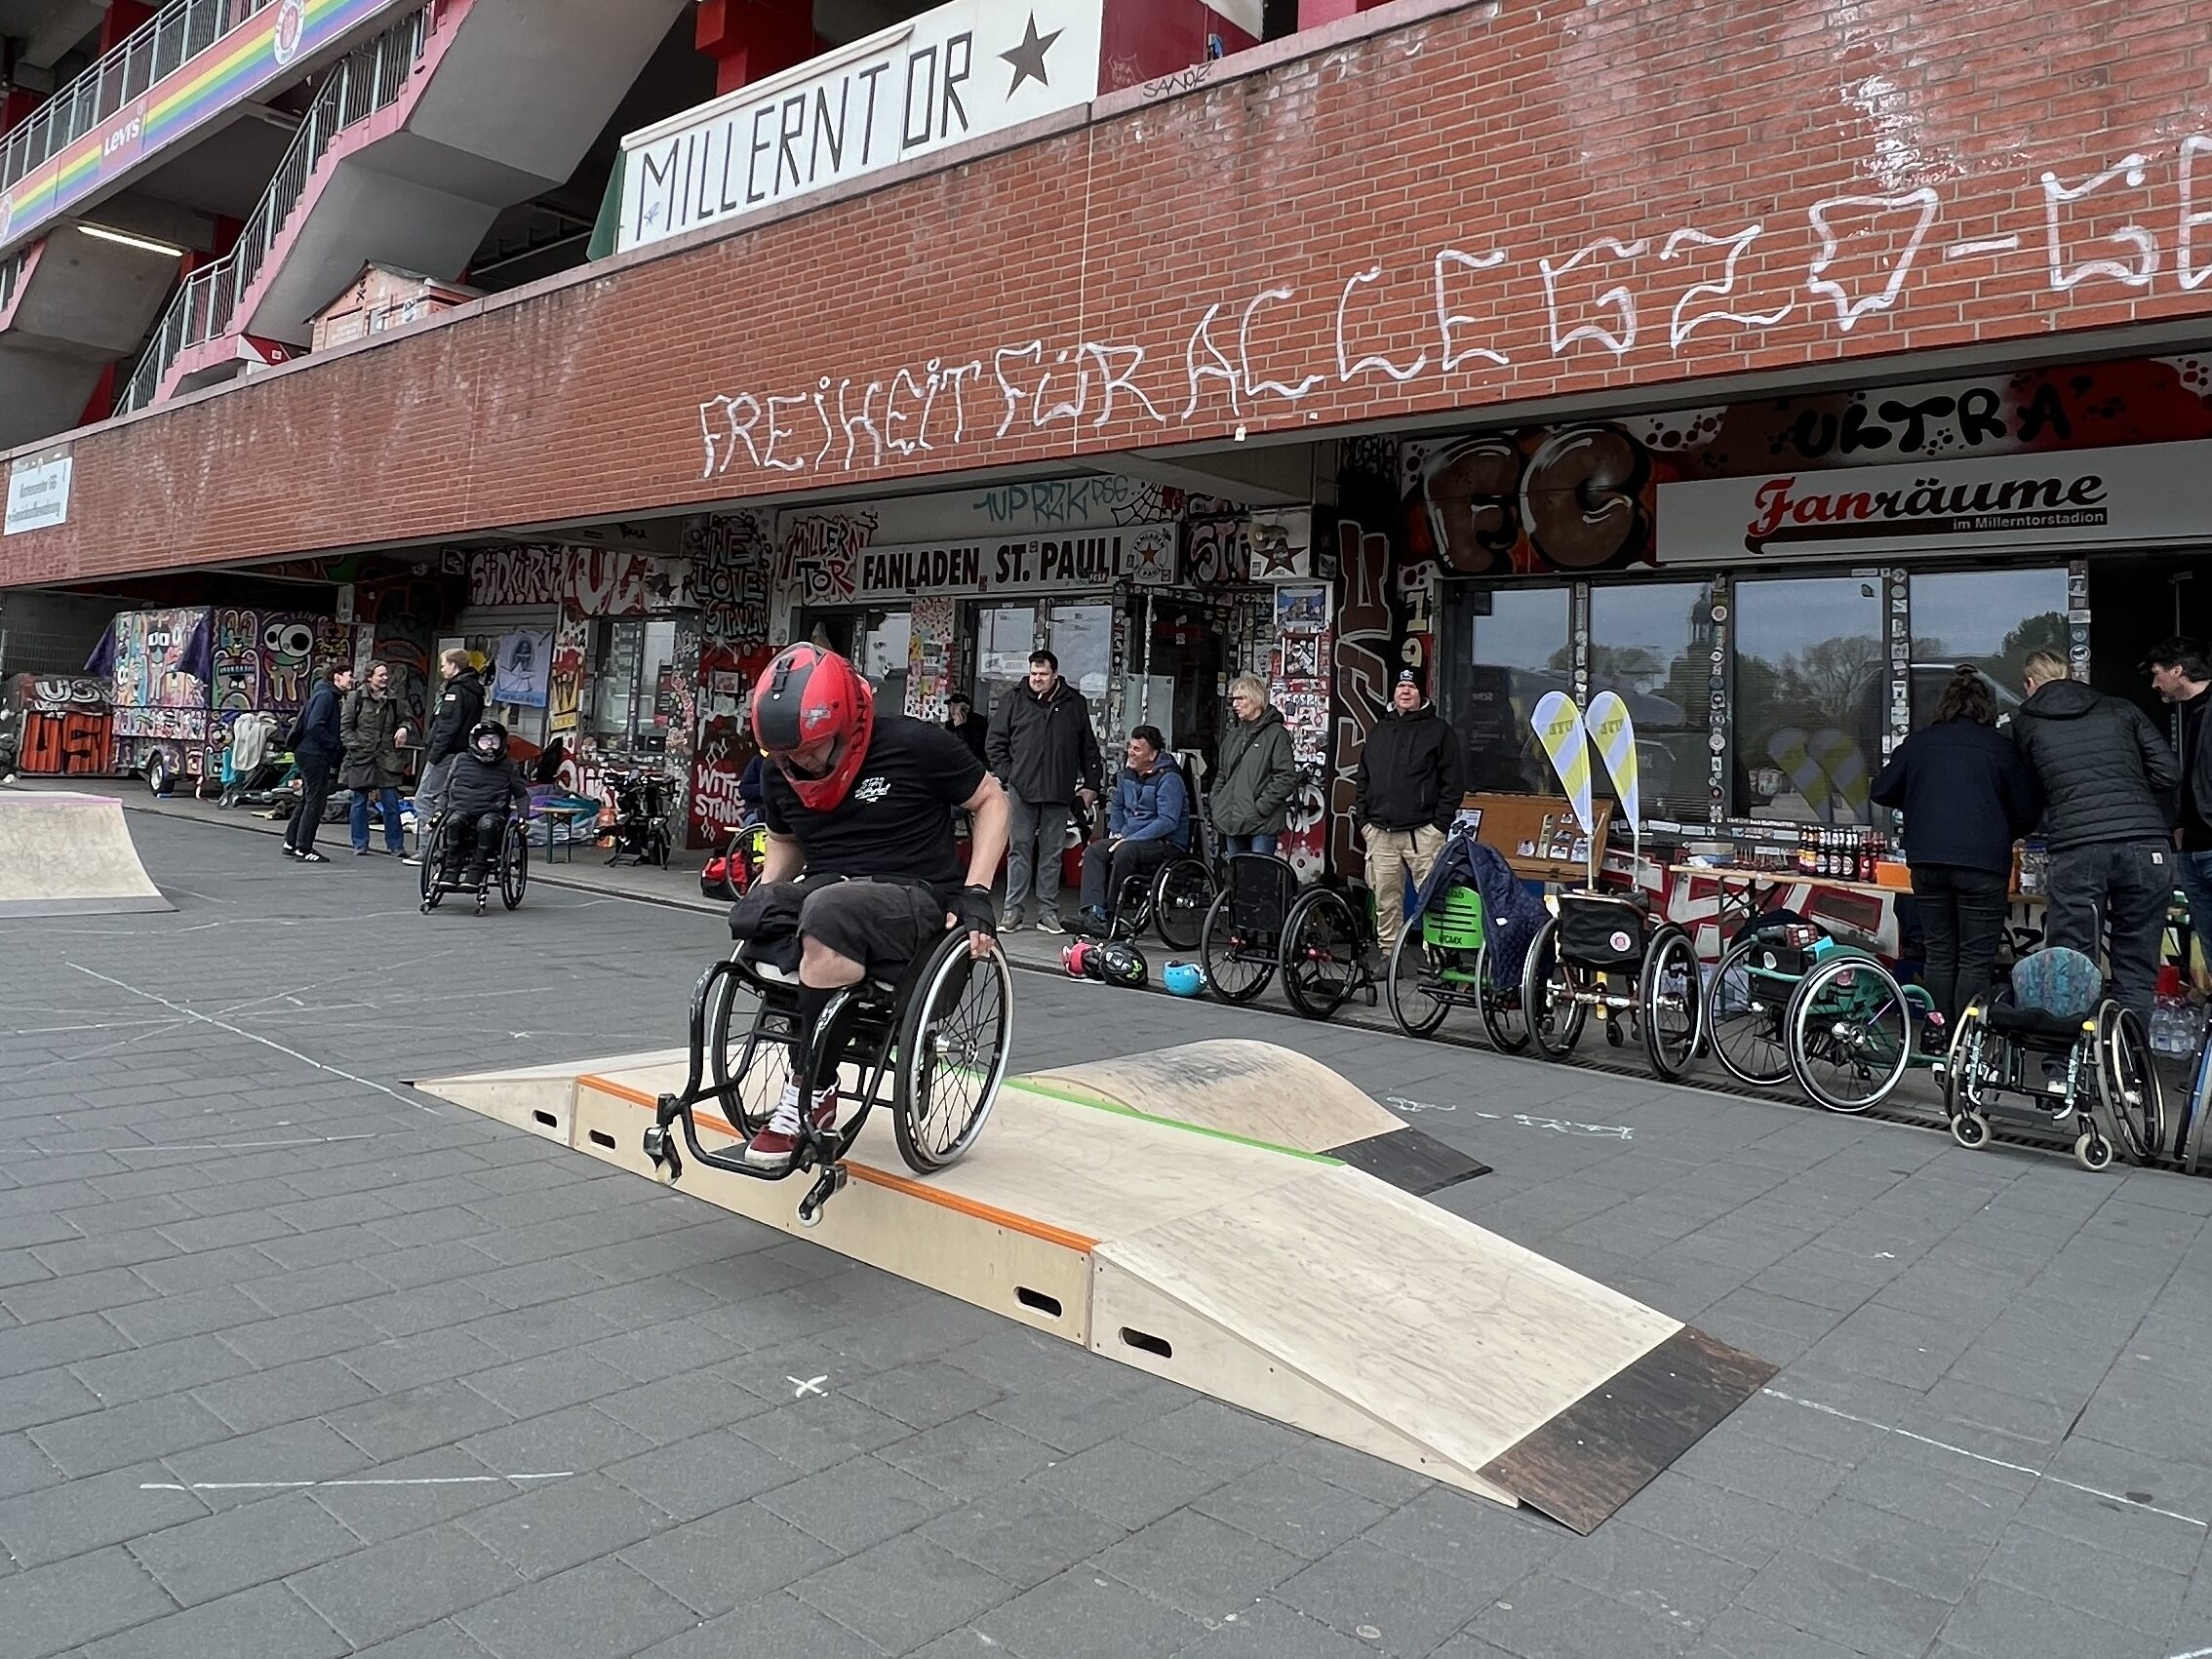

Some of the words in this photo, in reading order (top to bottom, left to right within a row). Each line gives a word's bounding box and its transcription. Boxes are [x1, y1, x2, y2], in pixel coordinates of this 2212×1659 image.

[636, 31, 972, 240] MILLERNTOR
[1746, 474, 2108, 535] Fanräume
[1954, 518, 1971, 530] im
[1976, 511, 2105, 528] Millerntorstadion
[696, 565, 765, 603] LOVE
[862, 547, 980, 589] FANLADEN
[996, 543, 1031, 583] ST.
[1040, 536, 1123, 581] PAULI
